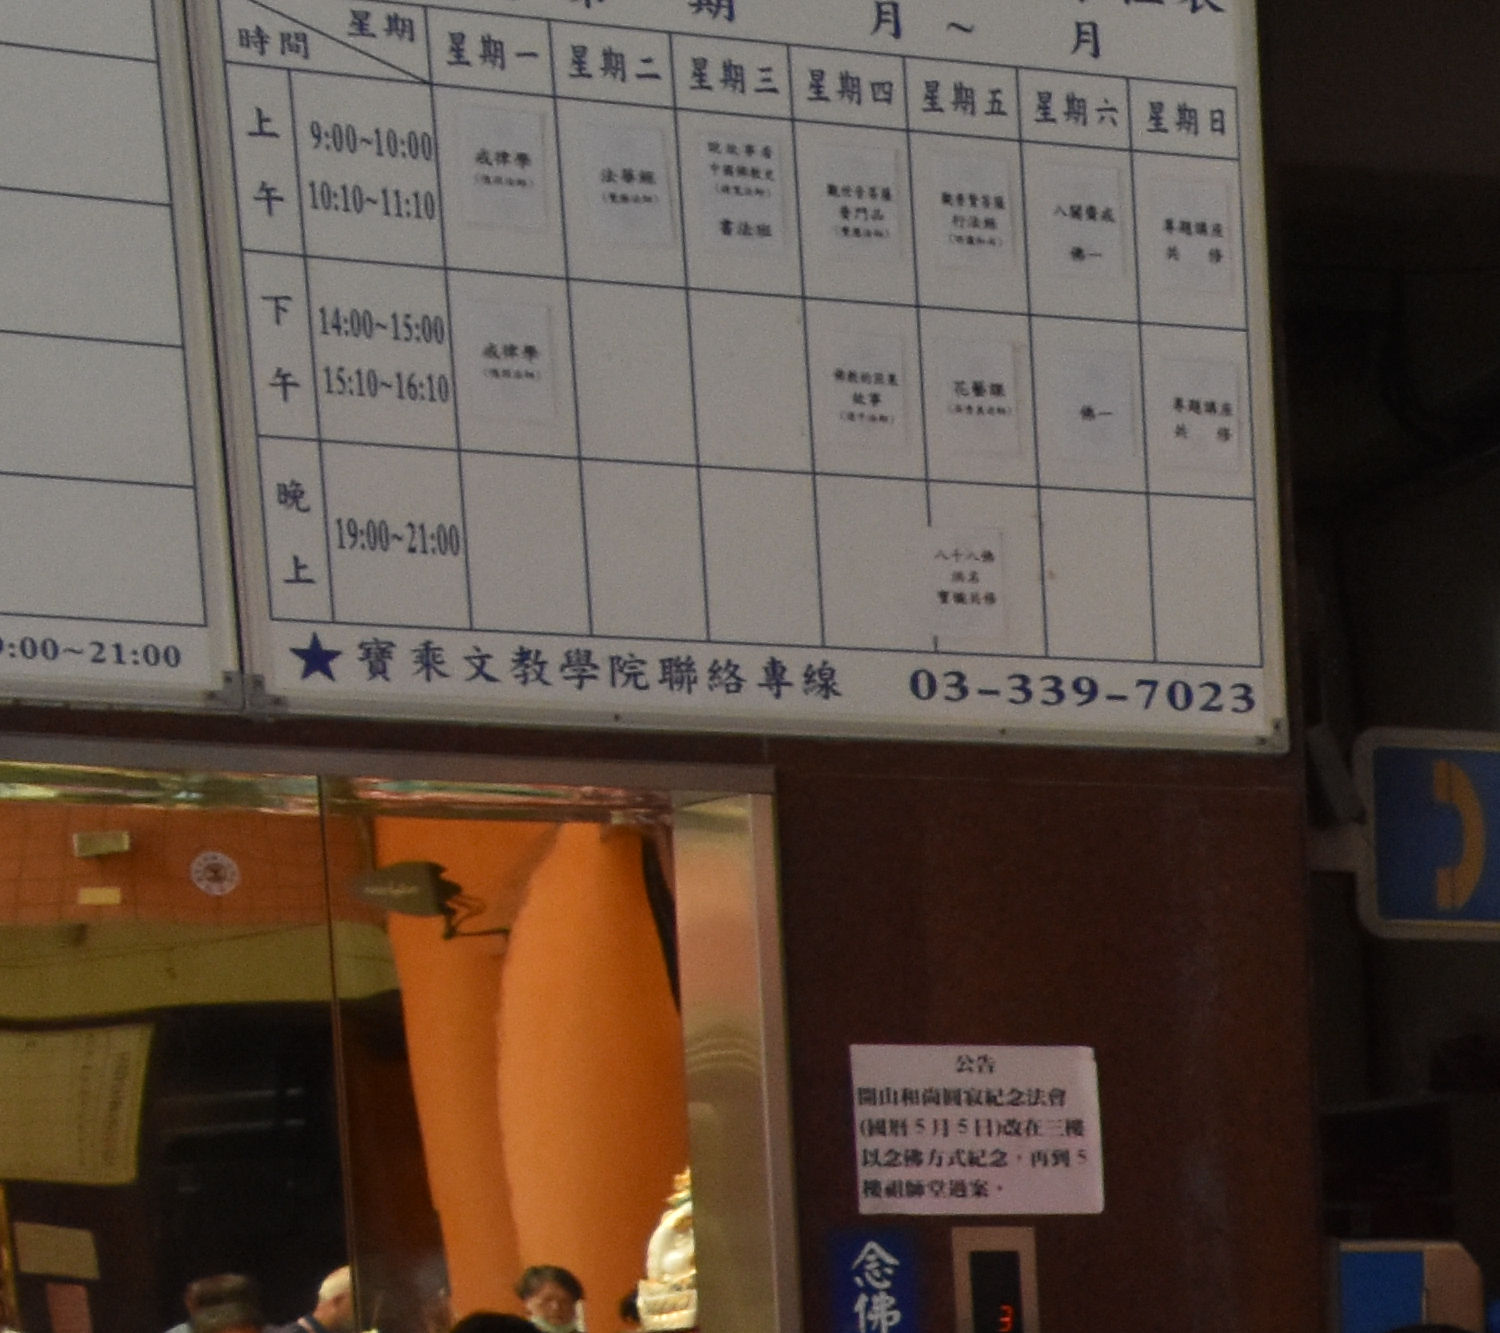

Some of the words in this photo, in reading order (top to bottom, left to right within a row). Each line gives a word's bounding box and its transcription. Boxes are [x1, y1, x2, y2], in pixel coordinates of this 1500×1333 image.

[238, 25, 310, 61] 時間
[349, 10, 415, 42] 星期
[446, 32, 540, 71] 星期一
[568, 45, 661, 82] 星期二
[690, 57, 781, 95] 星期三
[806, 68, 895, 105] 星期四
[921, 80, 1008, 118] 星期五
[1034, 90, 1119, 127] 星期六
[1146, 100, 1227, 137] 星期日
[310, 120, 434, 161] 9:00~10:00
[248, 107, 284, 218] 上午
[309, 180, 436, 221] 10:10~11:10
[318, 307, 446, 346] 14:00~15:00
[261, 294, 301, 402] 下午
[322, 366, 450, 403] 15:10~16:10
[275, 479, 317, 588] 晚上
[334, 517, 462, 558] 19:00~21:00
[0, 635, 183, 669] :00~21:00
[908, 667, 1258, 716] 03-339-7023
[955, 1053, 996, 1074] 公告
